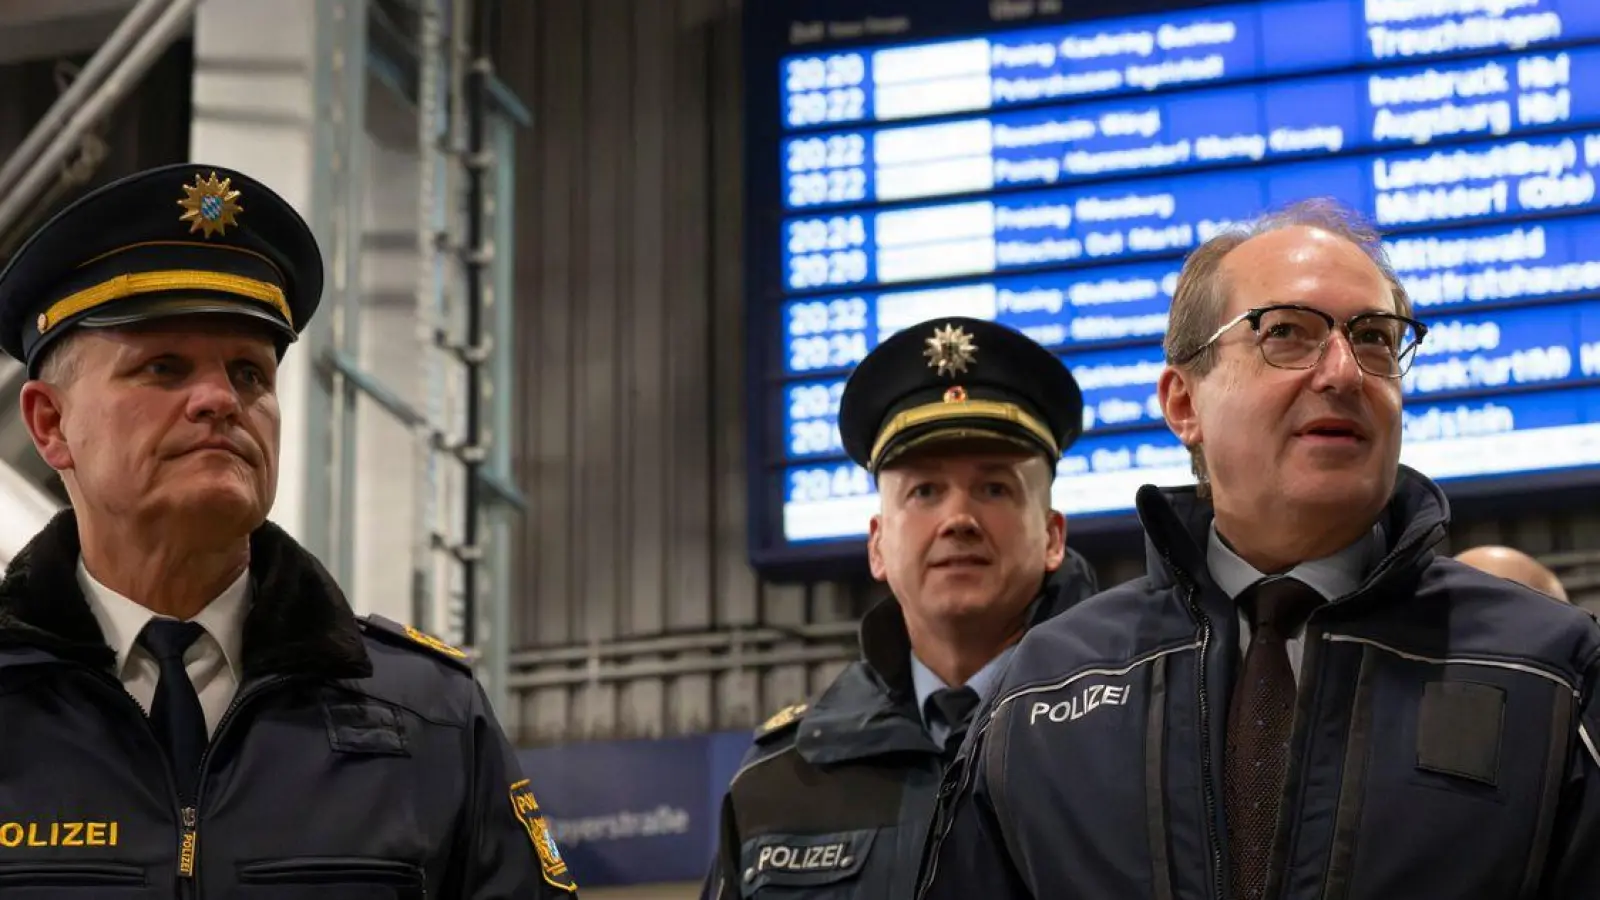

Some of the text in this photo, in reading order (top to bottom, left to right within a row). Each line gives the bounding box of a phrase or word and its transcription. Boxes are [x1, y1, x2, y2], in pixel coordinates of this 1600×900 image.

[1029, 684, 1131, 726] POLIZEI
[180, 832, 194, 873] POLIZEI
[757, 842, 845, 871] POLIZEI
